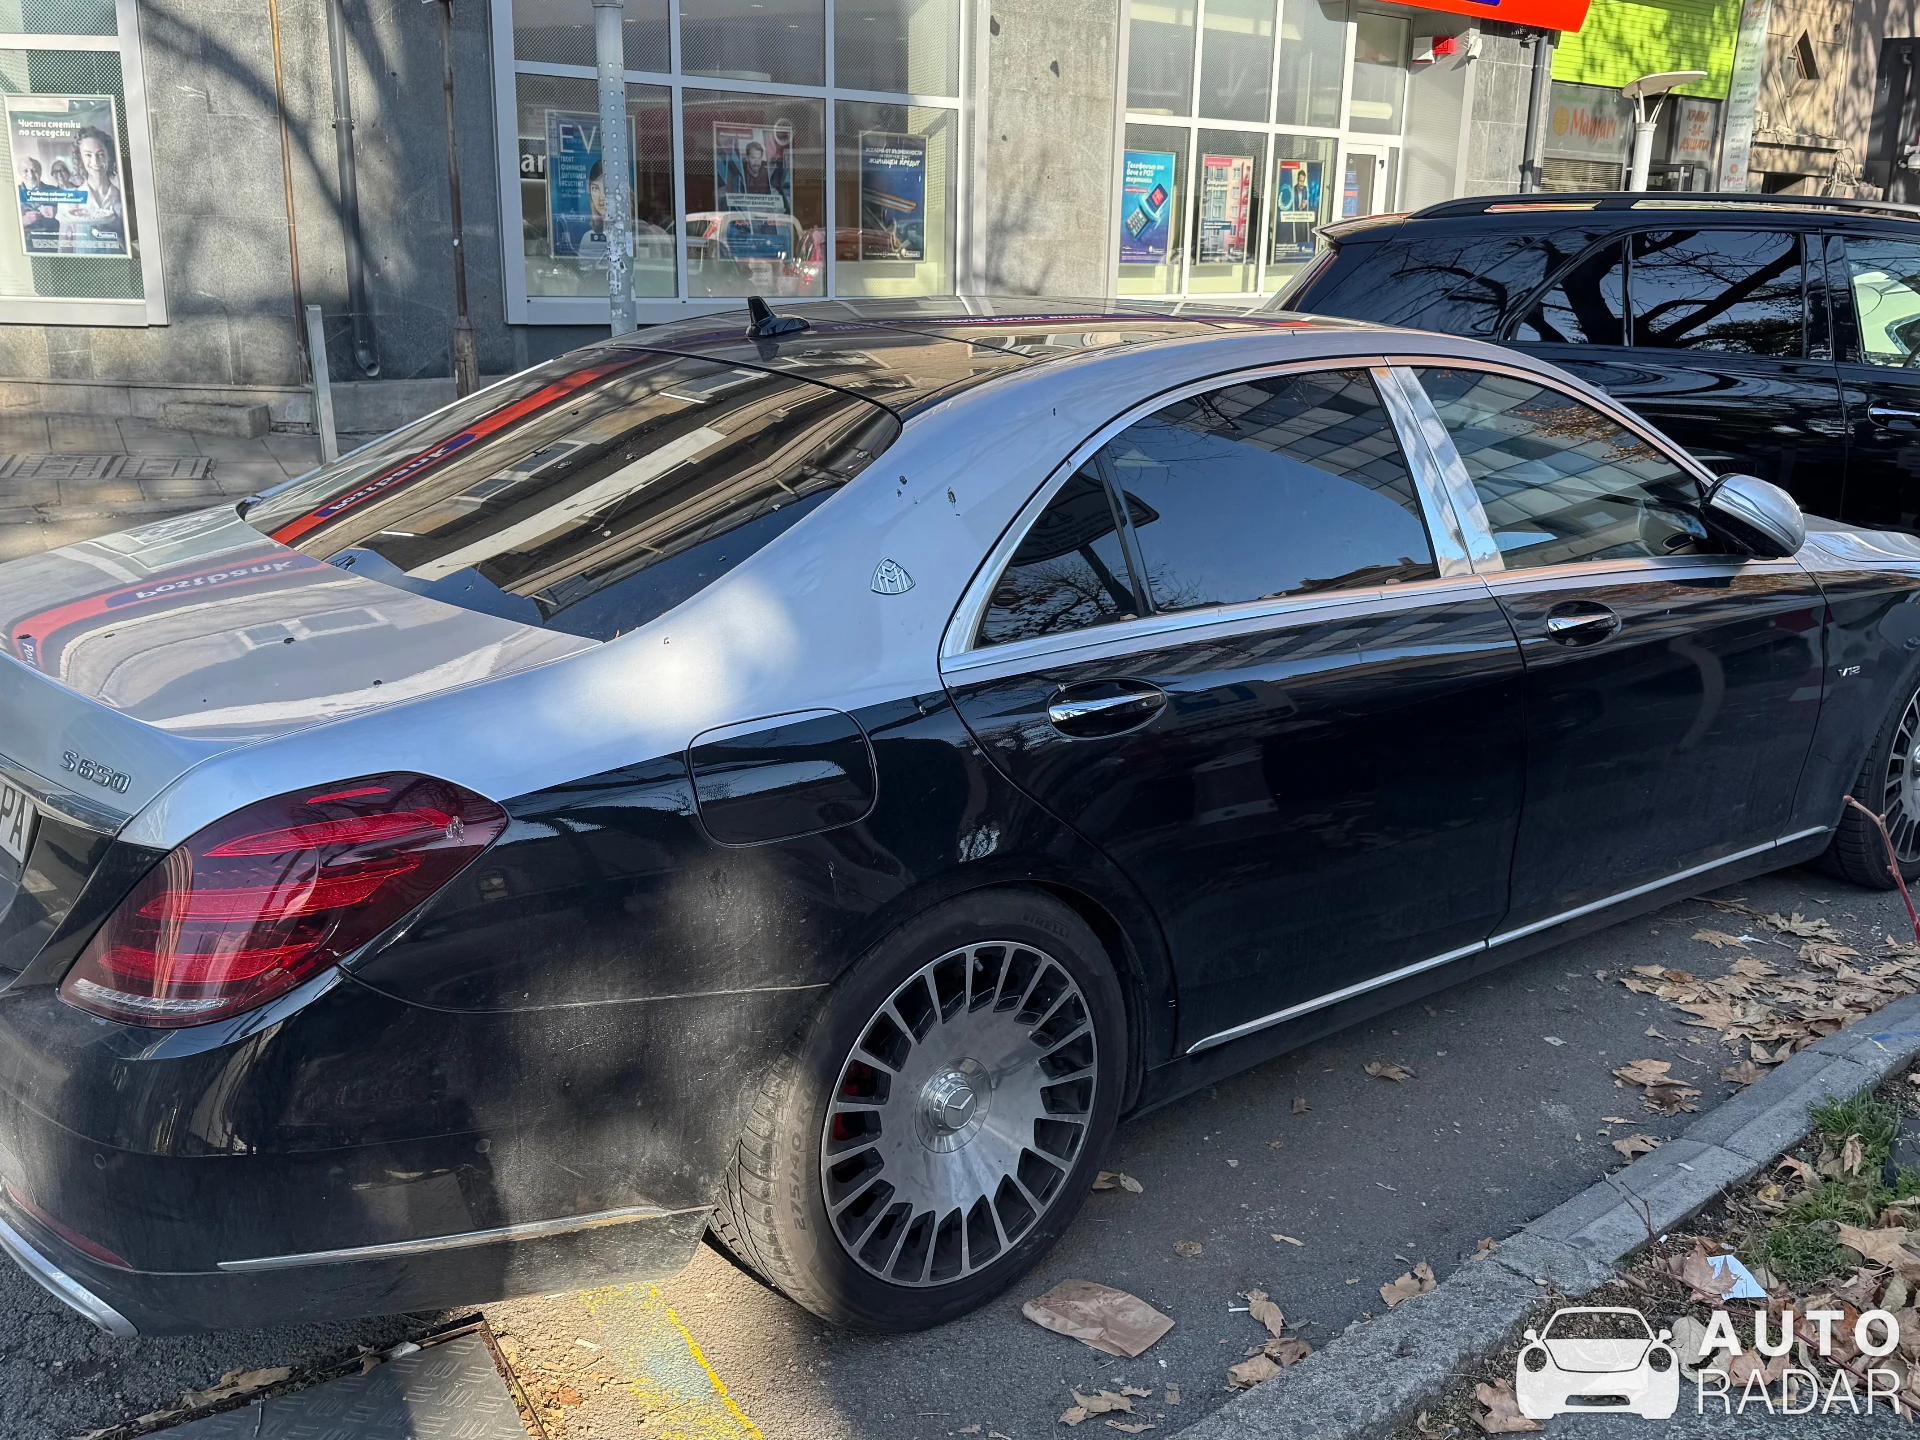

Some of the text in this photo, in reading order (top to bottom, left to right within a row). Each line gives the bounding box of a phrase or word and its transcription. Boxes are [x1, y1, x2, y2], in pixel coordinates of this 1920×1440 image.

[1686, 108, 1710, 123] ХРАНА
[18, 118, 81, 129] Чисти сметки
[1570, 107, 1617, 147] Manjari
[31, 129, 71, 138] съседски
[1680, 137, 1710, 151] ДУШАТА
[1127, 160, 1156, 170] Телефонът
[1126, 176, 1152, 184] терминал
[1837, 665, 1860, 677] V12
[59, 749, 131, 794] S 650
[1022, 910, 1070, 939] PIRELLI
[789, 1131, 807, 1230] 275/40
